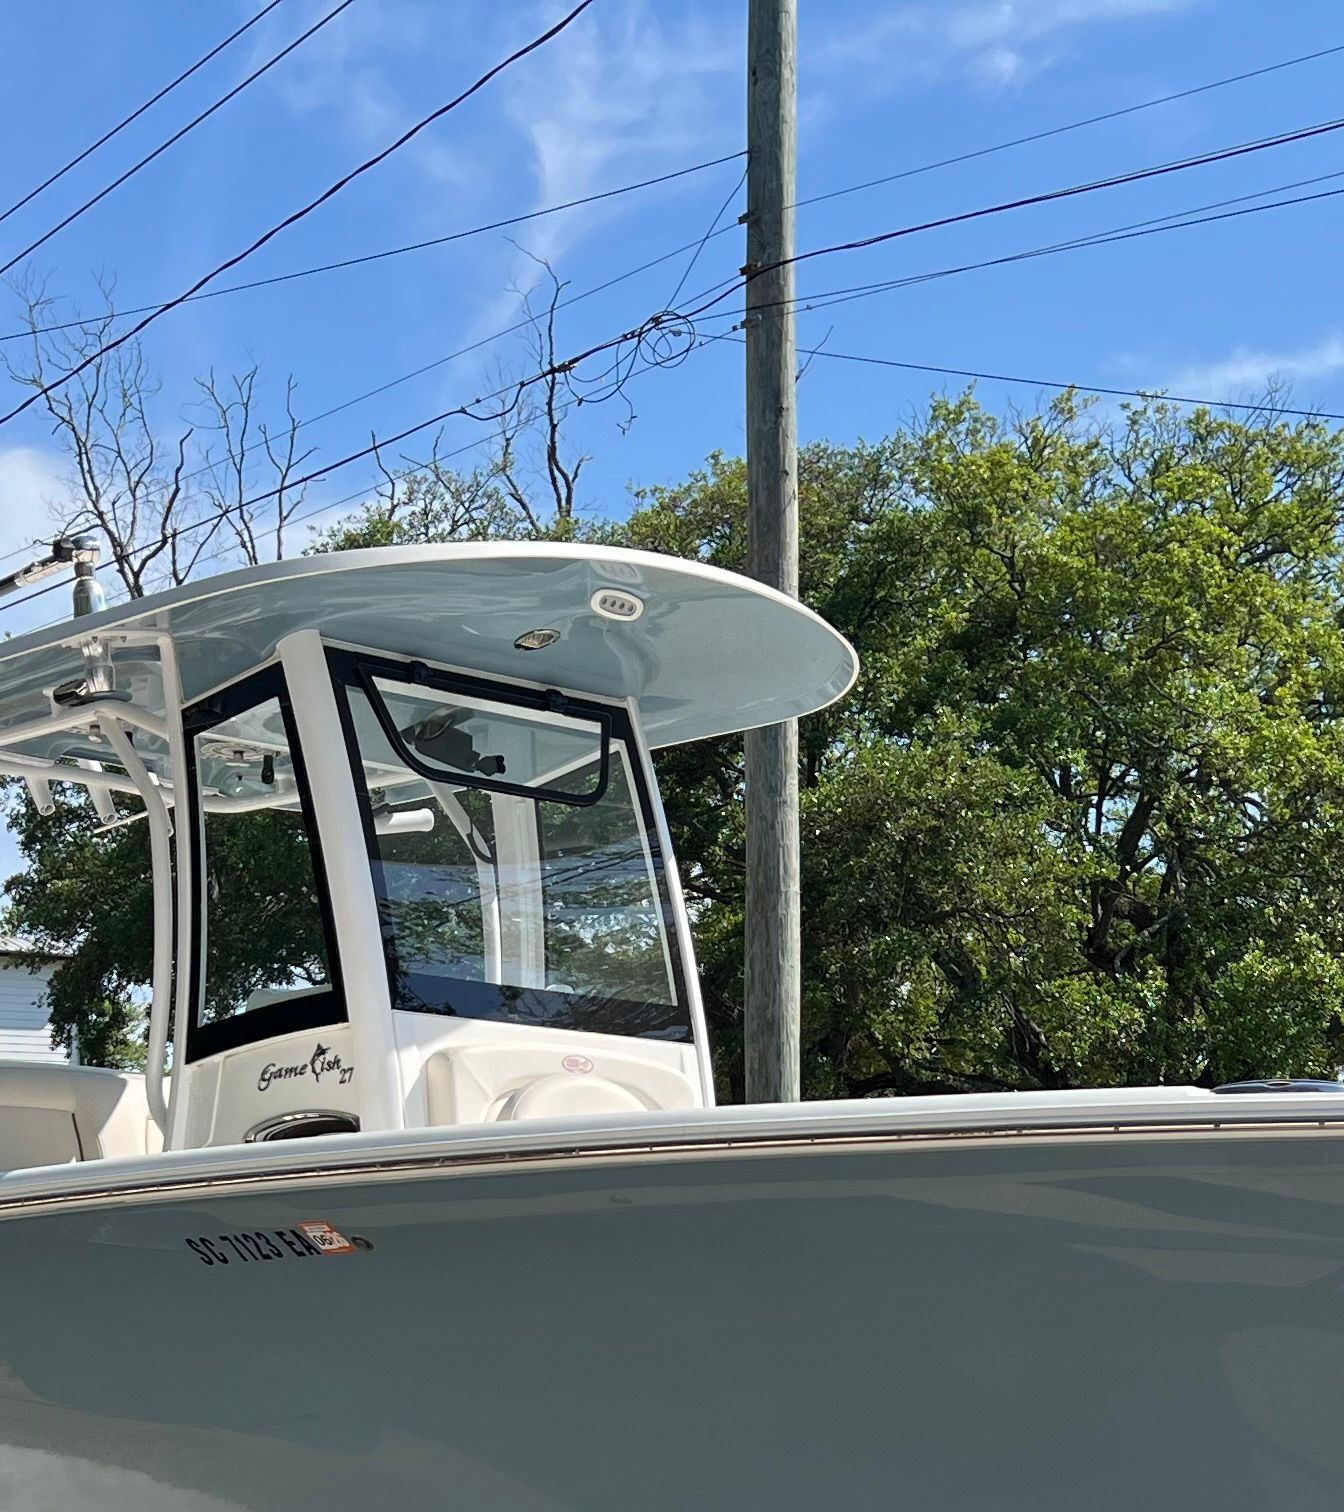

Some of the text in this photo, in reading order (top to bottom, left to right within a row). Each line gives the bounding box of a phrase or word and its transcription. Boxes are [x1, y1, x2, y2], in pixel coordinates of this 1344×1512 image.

[339, 1067, 354, 1084] 27
[185, 1237, 229, 1266] SC
[219, 1232, 284, 1262] 7123
[274, 1230, 322, 1257] EA
